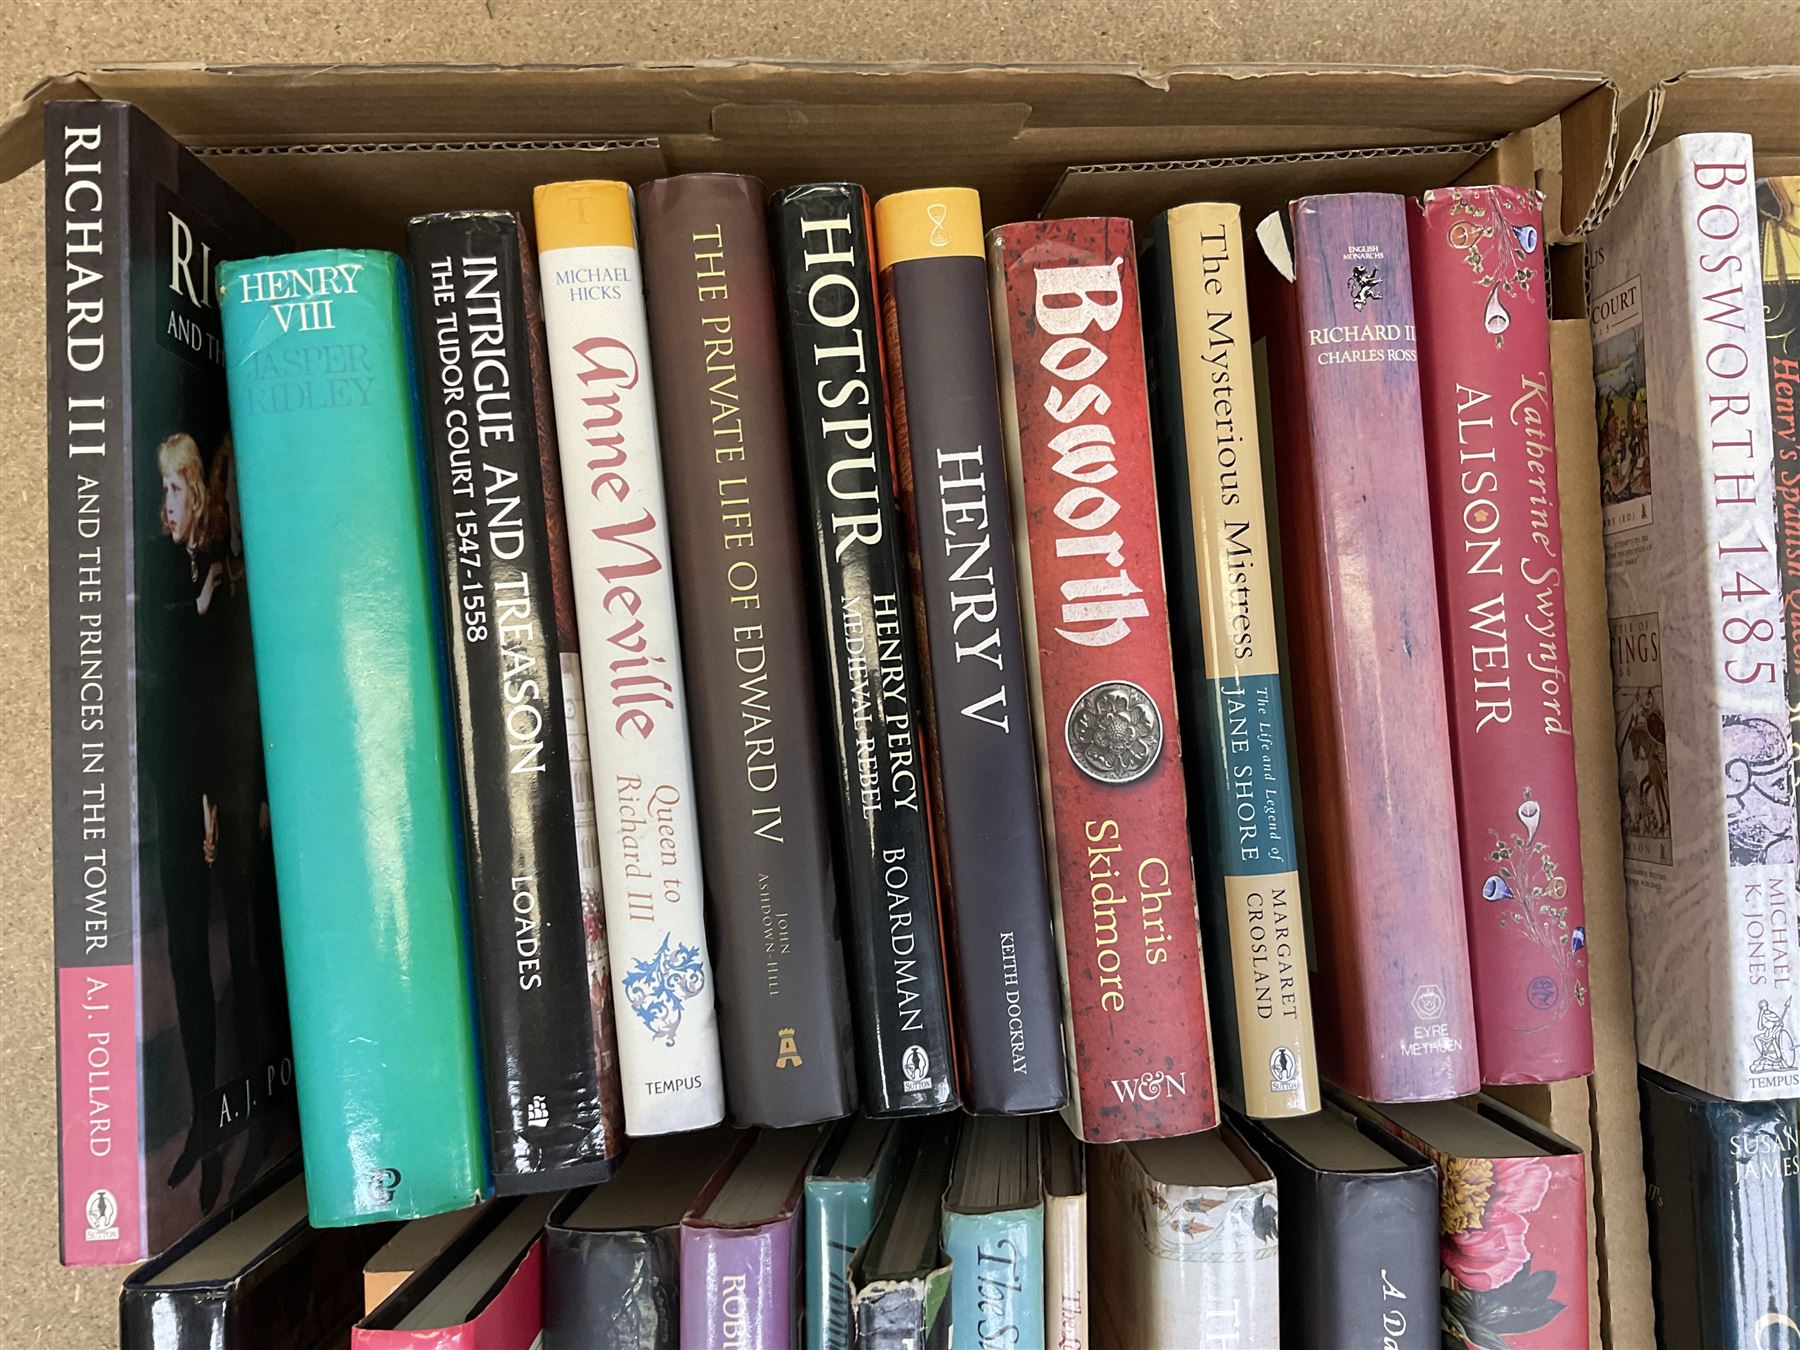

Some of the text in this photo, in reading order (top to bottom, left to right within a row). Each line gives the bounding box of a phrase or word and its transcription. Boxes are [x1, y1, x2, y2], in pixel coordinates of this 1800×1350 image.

[238, 263, 364, 303] HENRY
[555, 267, 632, 286] MICHAEL
[570, 286, 622, 301] HICKS
[1342, 245, 1385, 261] ENGLISH MONARCHS
[1592, 286, 1637, 325] COURT
[167, 310, 203, 351] AND
[248, 343, 373, 382] JASPER
[270, 299, 336, 333] VIII
[1308, 324, 1401, 346] RICHARD
[1317, 348, 1417, 365] CHARLES ROSS
[246, 377, 376, 414] RIDLEY
[800, 212, 885, 562] HOTSPUR
[1200, 224, 1255, 660] The Mysterious Mistress
[1693, 159, 1776, 684] BOSWORTH 1485
[1773, 356, 1800, 461] Henry's
[430, 256, 488, 643] THE TUDOR COURT 1547-1558
[1034, 256, 1150, 647] Bosworth
[64, 125, 108, 955] RICHARD III AND THE PRINCES IN THE TOWER
[462, 256, 546, 774] INTRIGUE AND TREASON
[571, 337, 674, 740] Anne Neville
[692, 223, 784, 844] THE PRIVATE LIFE OF EDWARD IV
[1455, 382, 1512, 734] ALISON WEIR
[1509, 371, 1571, 736] Katherine Swynford
[936, 445, 1009, 734] HENRY V
[840, 595, 882, 820] MEDIEVAL REBEL
[873, 593, 918, 812] HENRY PERCY
[1221, 686, 1259, 861] JANE SHORE
[1256, 687, 1284, 863] The Life and Legend of
[614, 774, 656, 923] Richard III
[646, 783, 682, 904] Queen to
[511, 875, 542, 992] LOADES
[758, 872, 780, 997] ASHDOWN-HILL
[776, 912, 790, 954] JOHN
[883, 847, 924, 1032] BOARDMAN
[1083, 819, 1126, 1013] Skidmore
[1137, 857, 1172, 967] Chris
[1246, 892, 1274, 1020] CROSLAND
[1271, 888, 1299, 1021] MARGARET
[1742, 911, 1768, 985] JONES
[1768, 878, 1791, 989] MICHAEL
[1000, 931, 1028, 1075] KEITH DOCKRAY
[1400, 1038, 1463, 1056] METHUEN
[1414, 1023, 1449, 1039] EYRE
[87, 1032, 112, 1158] POLLARD
[645, 1075, 703, 1096] TEMPUS
[905, 1081, 931, 1091] SUTTON
[1110, 1071, 1187, 1104] W&N
[1749, 1074, 1800, 1089] TEMPUS
[1730, 1127, 1800, 1157] SUSAN
[1734, 1155, 1800, 1185] JAMES
[977, 1238, 1022, 1317] The
[1381, 1268, 1407, 1300] A
